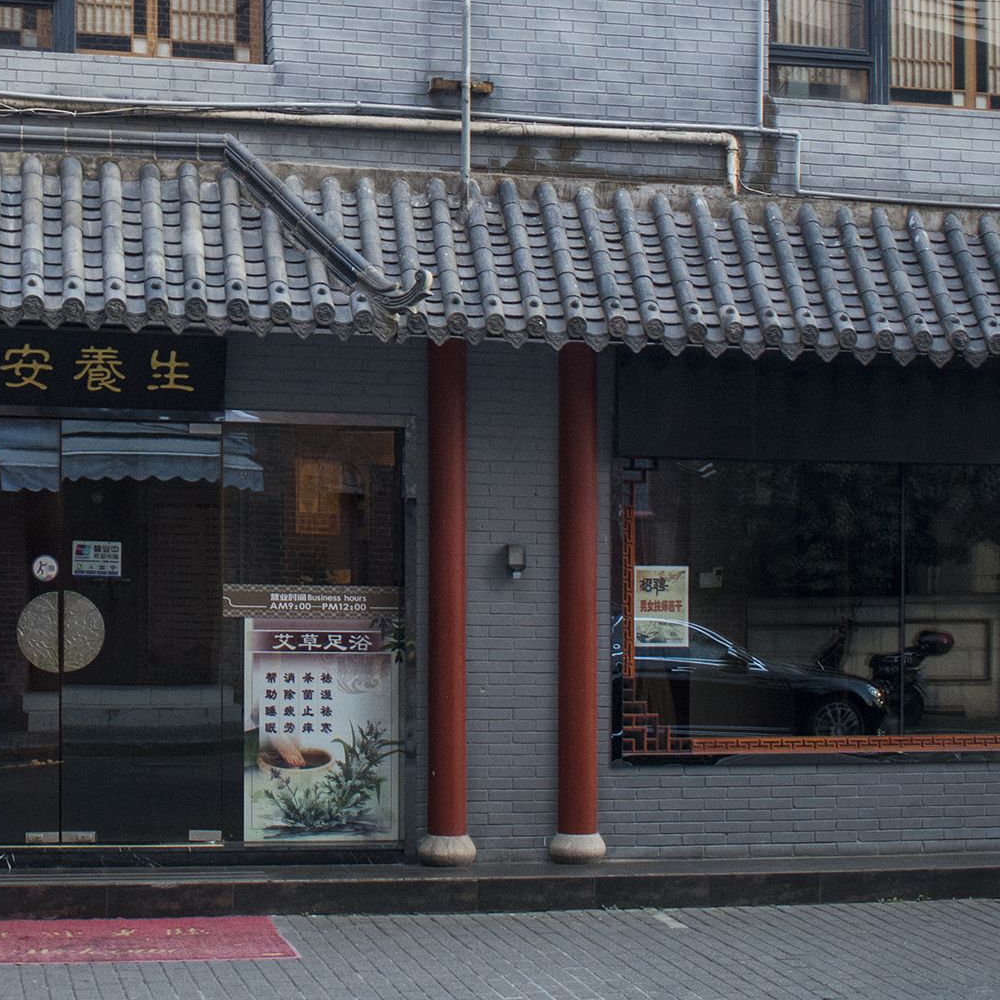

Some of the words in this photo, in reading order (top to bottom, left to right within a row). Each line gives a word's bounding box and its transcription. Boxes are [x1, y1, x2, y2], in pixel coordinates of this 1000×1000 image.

[307, 593, 341, 602] Business
[343, 593, 367, 602] hours
[272, 633, 373, 651] 艾草足浴
[265, 672, 277, 734] 帮助睡眠
[283, 672, 296, 734] 消除疲劳
[302, 672, 315, 734] 杀菌止痒
[320, 672, 333, 734] 祛湿祛寒
